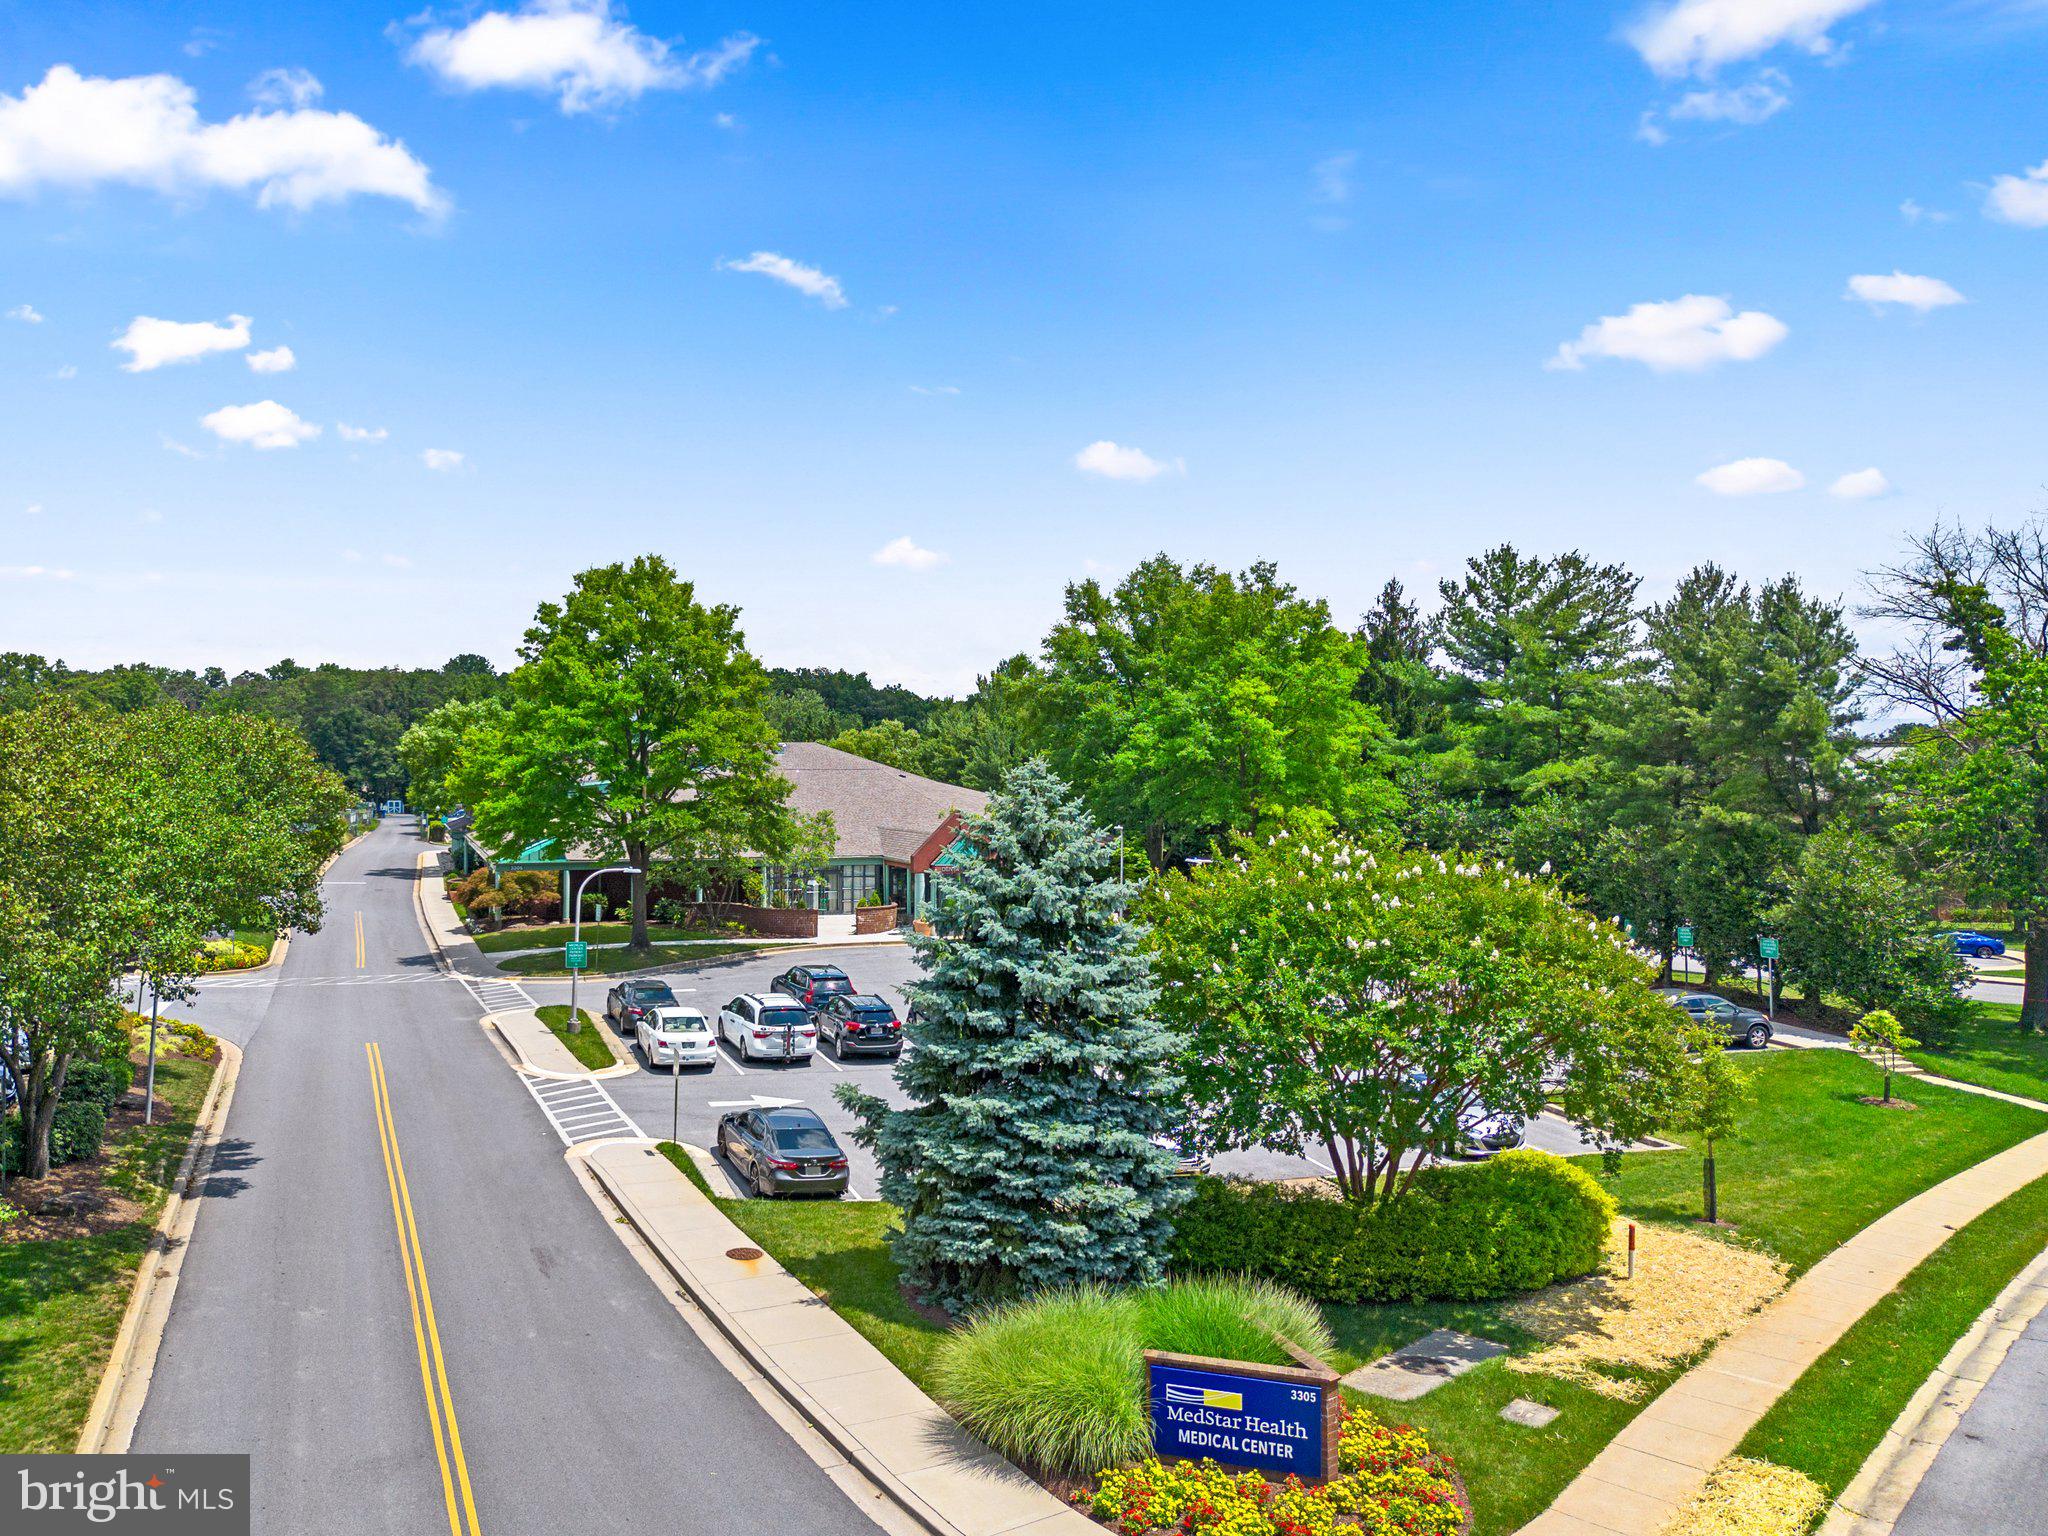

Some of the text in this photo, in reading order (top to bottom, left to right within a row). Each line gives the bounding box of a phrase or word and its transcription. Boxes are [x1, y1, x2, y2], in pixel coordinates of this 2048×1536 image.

[1290, 1389, 1317, 1403] 3305
[1166, 1405, 1309, 1440] MedStar Health
[1178, 1428, 1294, 1459] MEDICAL CENTER
